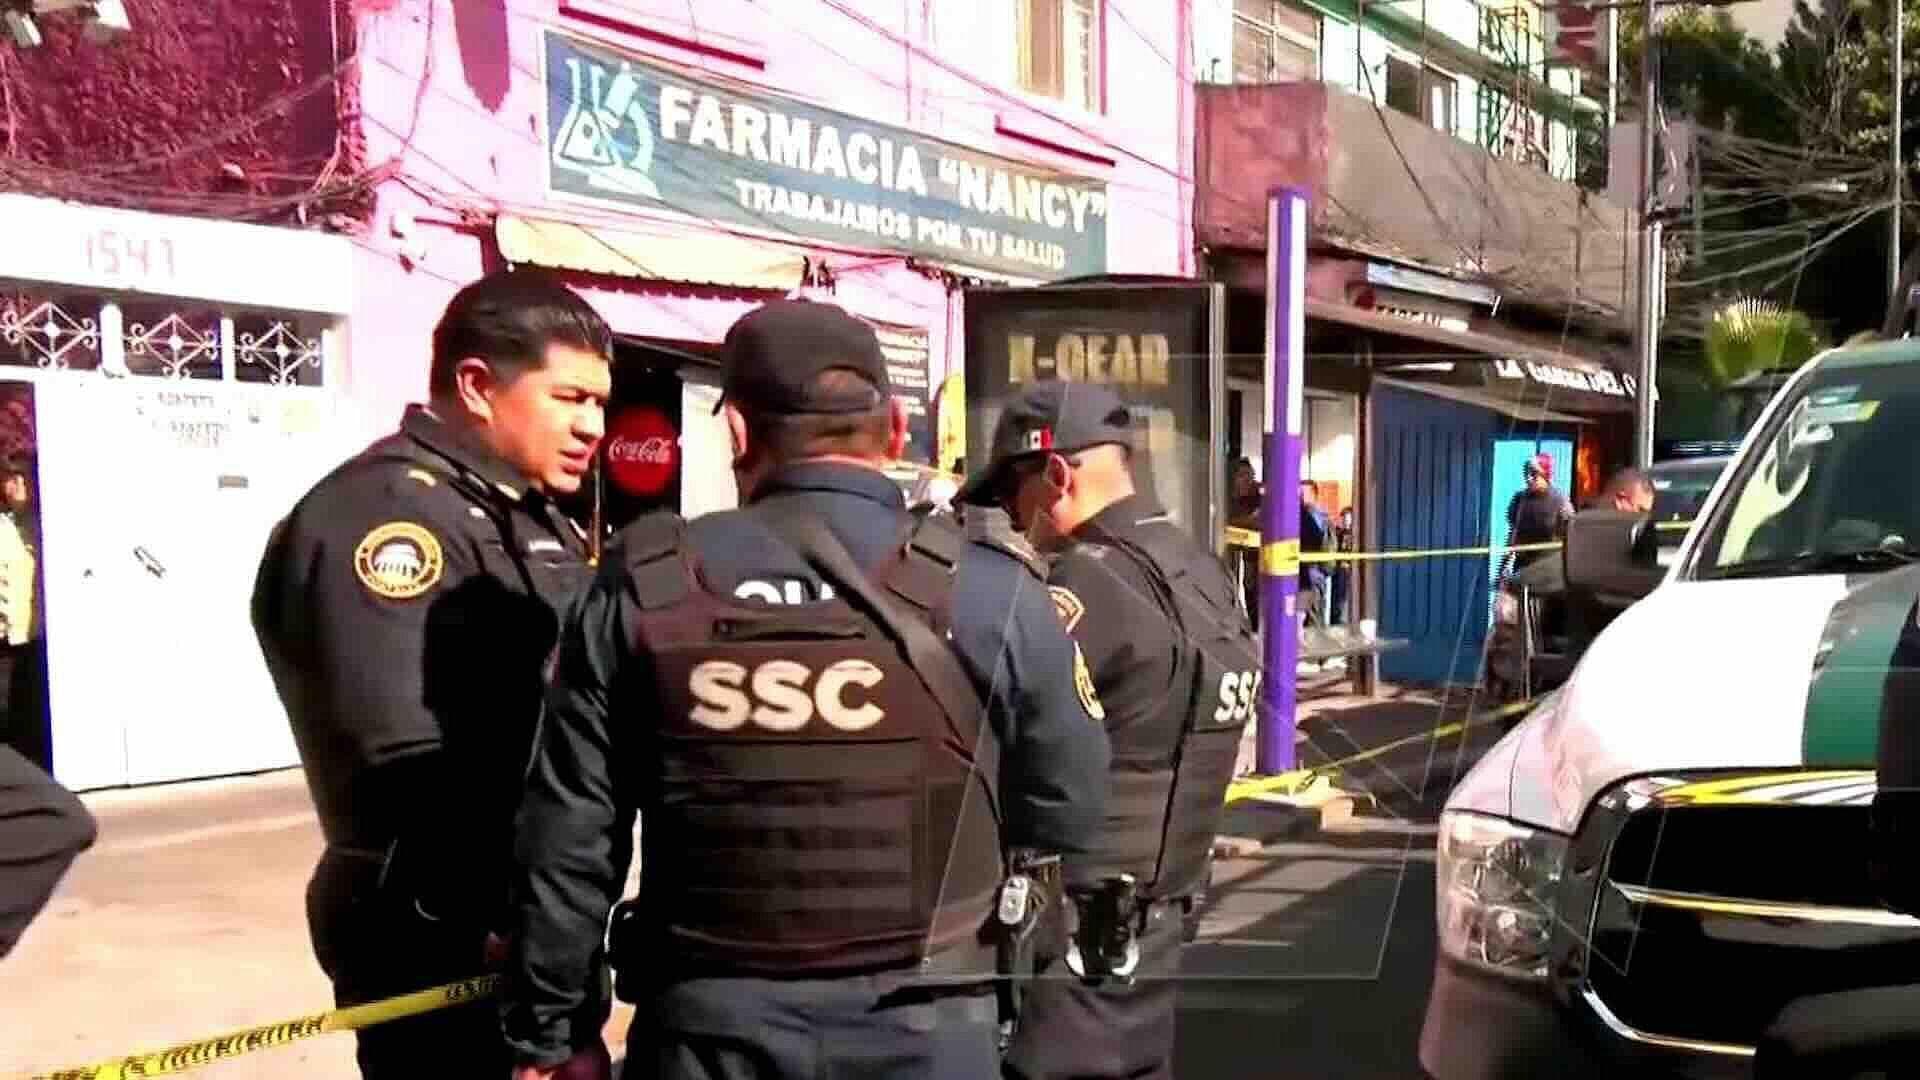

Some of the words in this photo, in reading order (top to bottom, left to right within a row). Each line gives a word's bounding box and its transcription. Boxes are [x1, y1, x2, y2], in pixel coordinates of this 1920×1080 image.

[659, 84, 928, 197] FARMACIA
[735, 178, 912, 240] TRABAJAMOS
[917, 217, 961, 248] POR
[967, 226, 997, 257] TU
[1001, 234, 1066, 271] SALUD
[688, 658, 886, 732] SSC
[1213, 668, 1262, 722] SS
